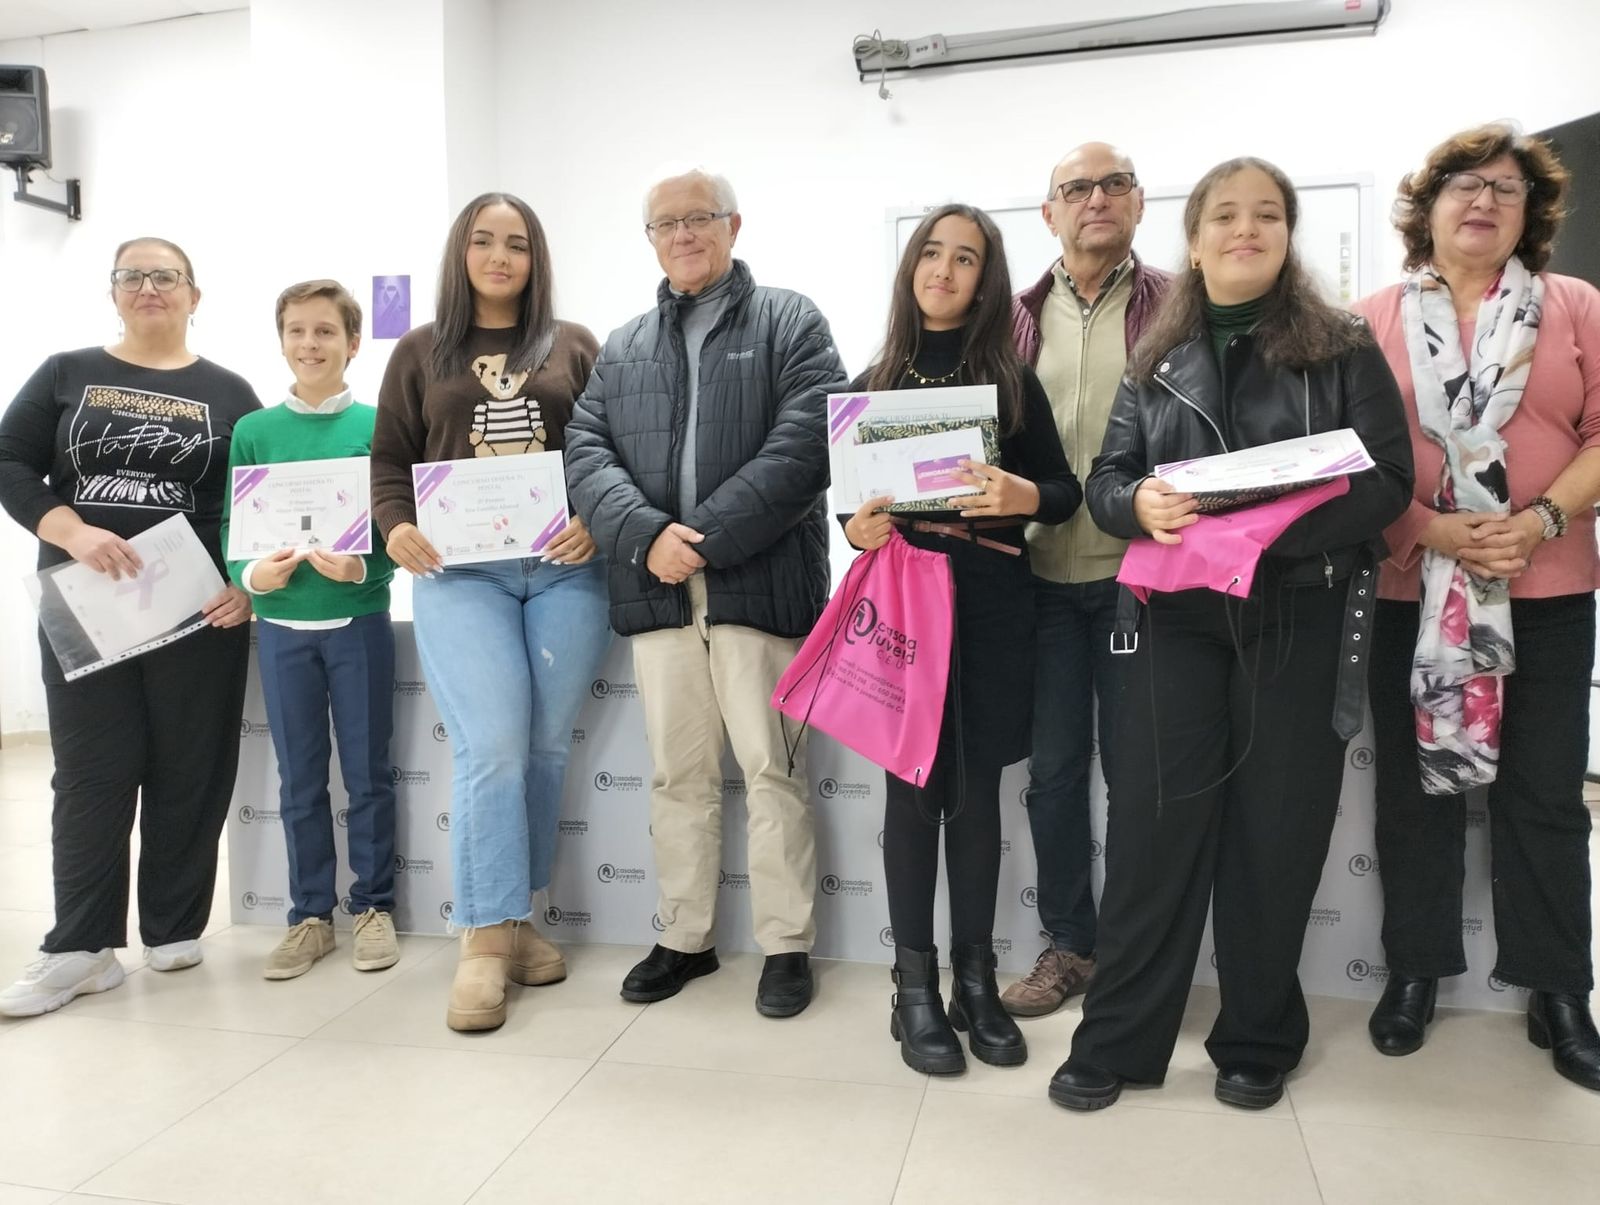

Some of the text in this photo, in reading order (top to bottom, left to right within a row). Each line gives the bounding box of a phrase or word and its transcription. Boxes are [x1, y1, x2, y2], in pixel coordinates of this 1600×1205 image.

[111, 409, 174, 423] CHOOSE TO BE
[116, 468, 157, 479] EVERYDAY
